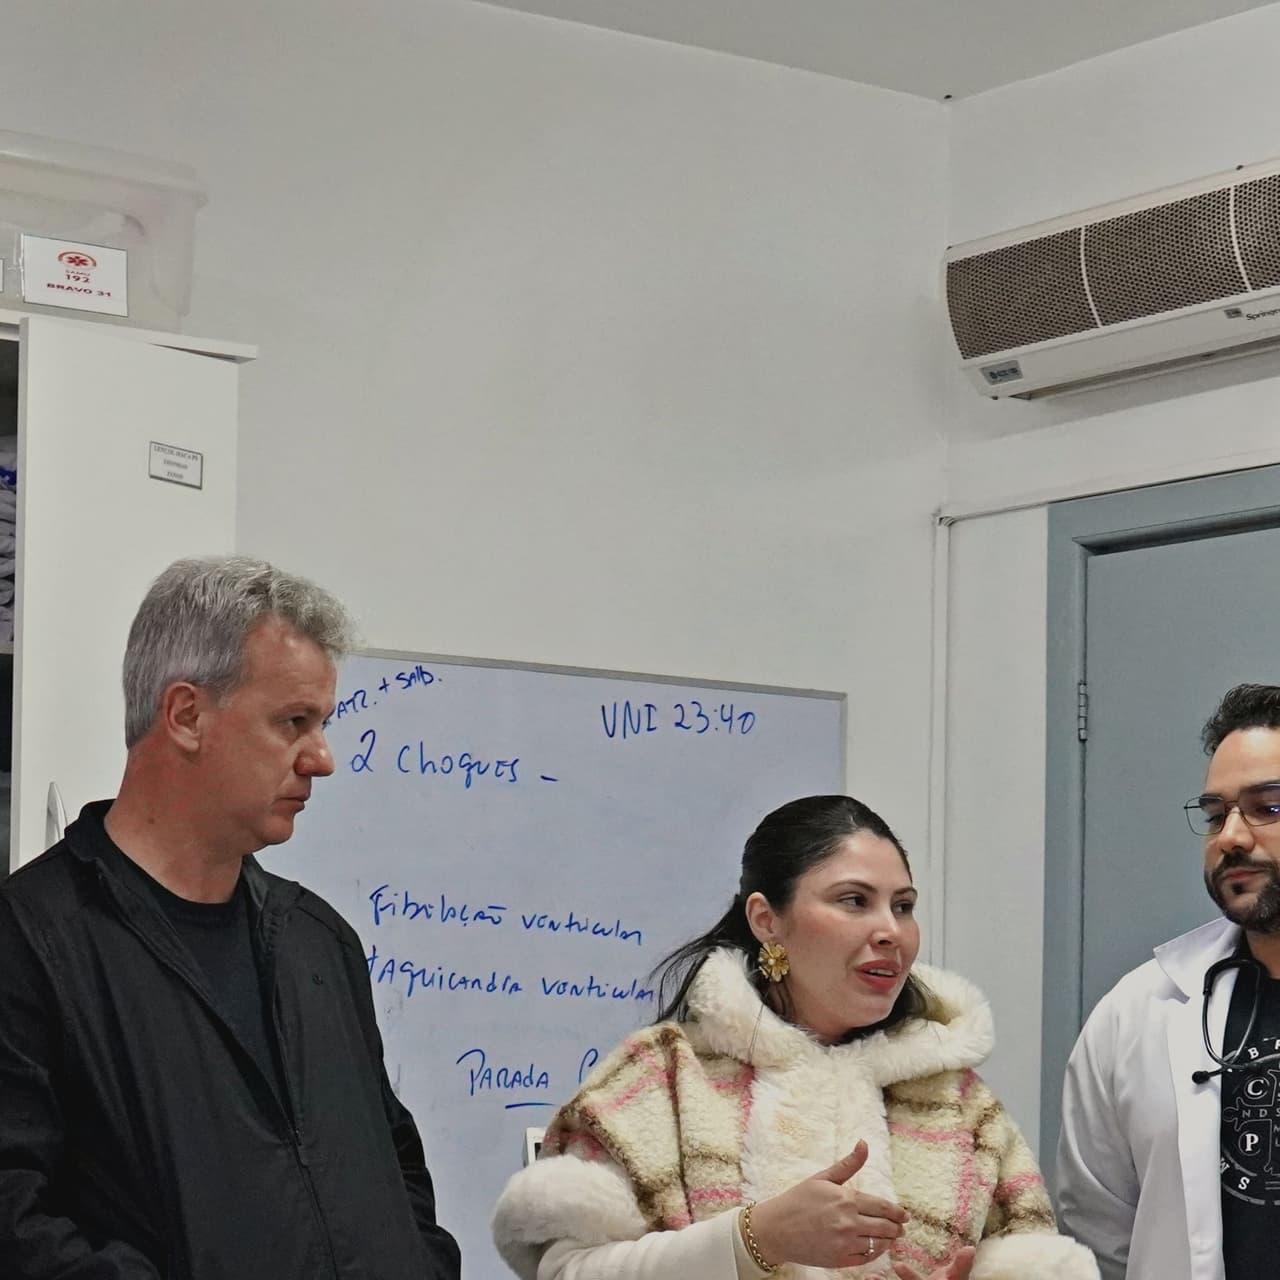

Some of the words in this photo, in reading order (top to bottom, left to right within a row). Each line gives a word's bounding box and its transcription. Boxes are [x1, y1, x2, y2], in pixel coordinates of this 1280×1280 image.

[46, 283, 92, 294] BRAVO
[65, 273, 90, 283] 192
[600, 701, 658, 740] VNI
[673, 702, 757, 736] 23:40
[349, 729, 378, 773] 2
